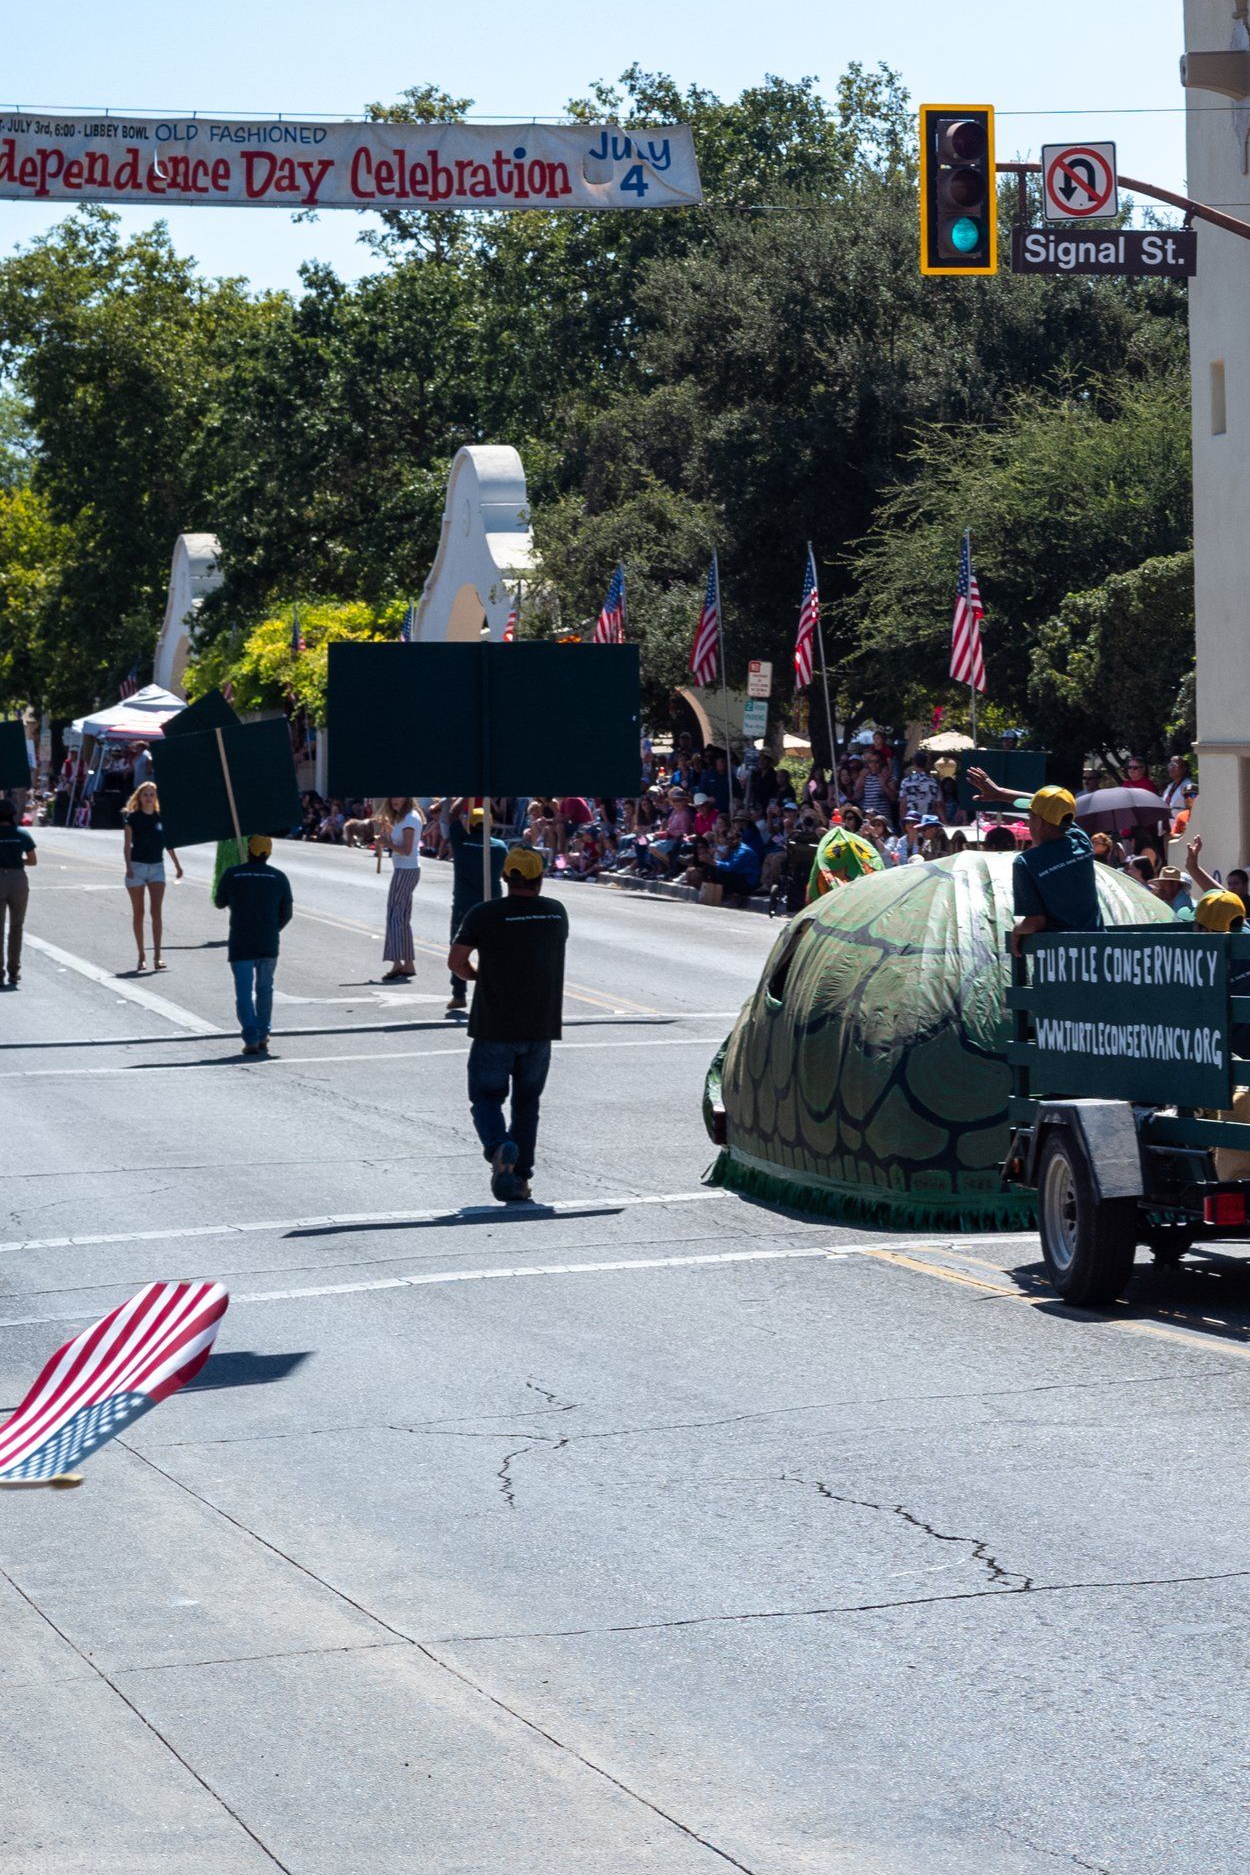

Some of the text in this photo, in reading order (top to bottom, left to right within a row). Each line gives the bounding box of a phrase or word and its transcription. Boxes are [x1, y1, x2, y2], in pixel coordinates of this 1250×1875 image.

[8, 119, 32, 134] JULY
[34, 121, 52, 138] 3rd,
[55, 123, 75, 138] 6:00
[84, 124, 119, 138] LIBBEY
[121, 125, 149, 140] BOWL
[155, 123, 327, 144] OLD FASHIONED
[589, 131, 671, 171] July
[240, 150, 335, 206] Day
[350, 146, 572, 202] Celebration
[620, 165, 649, 197] 4
[1024, 234, 1185, 269] Signal St.
[1036, 945, 1217, 987] TURTLE CONSERVANCY
